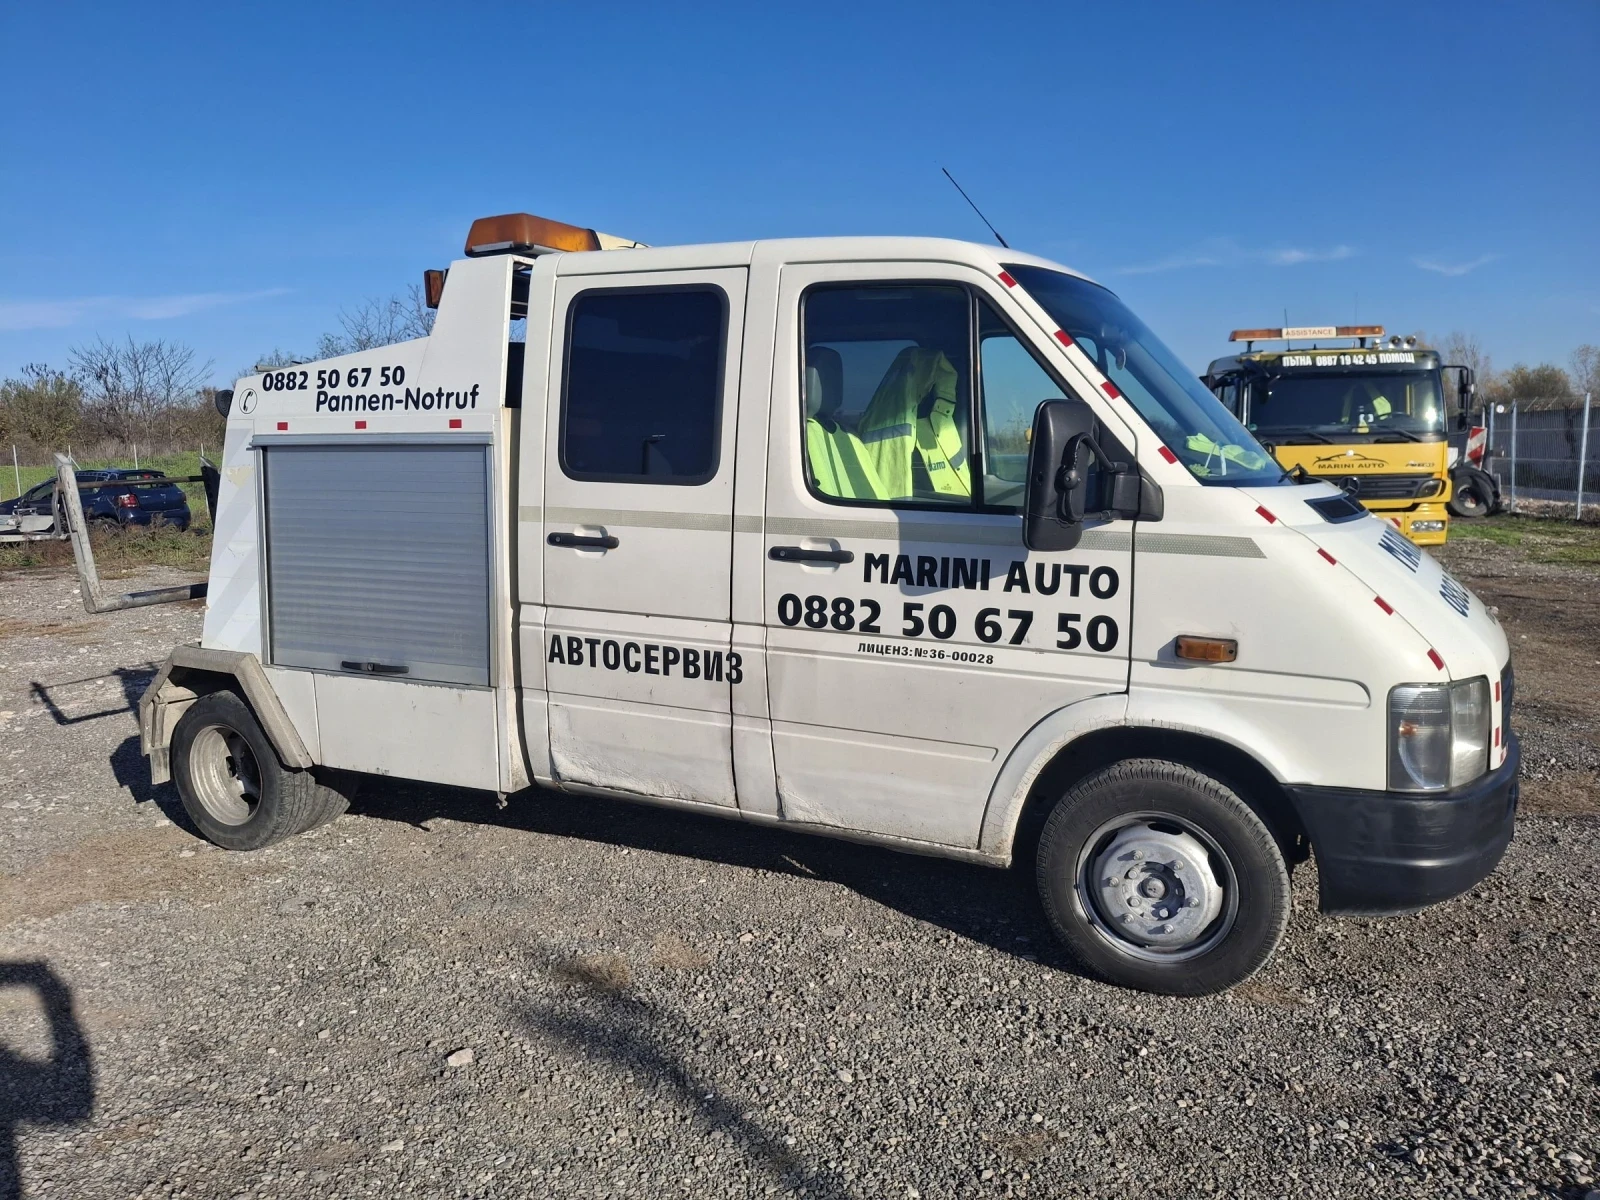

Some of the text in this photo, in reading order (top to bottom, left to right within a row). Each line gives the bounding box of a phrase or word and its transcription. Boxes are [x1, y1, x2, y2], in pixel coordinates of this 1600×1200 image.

[1285, 327, 1333, 337] ASSISTANCE
[1282, 352, 1415, 367] ПЪТНА 0887 19 42 45 ПОМОЩ
[261, 365, 406, 392] 0882 50 67 50
[316, 384, 480, 413] Pannen-Notruf
[864, 552, 1120, 600] MARINI AUTO
[777, 593, 1119, 653] 0882 50 67 50
[548, 634, 743, 684] АВТОСЕРВИЗ
